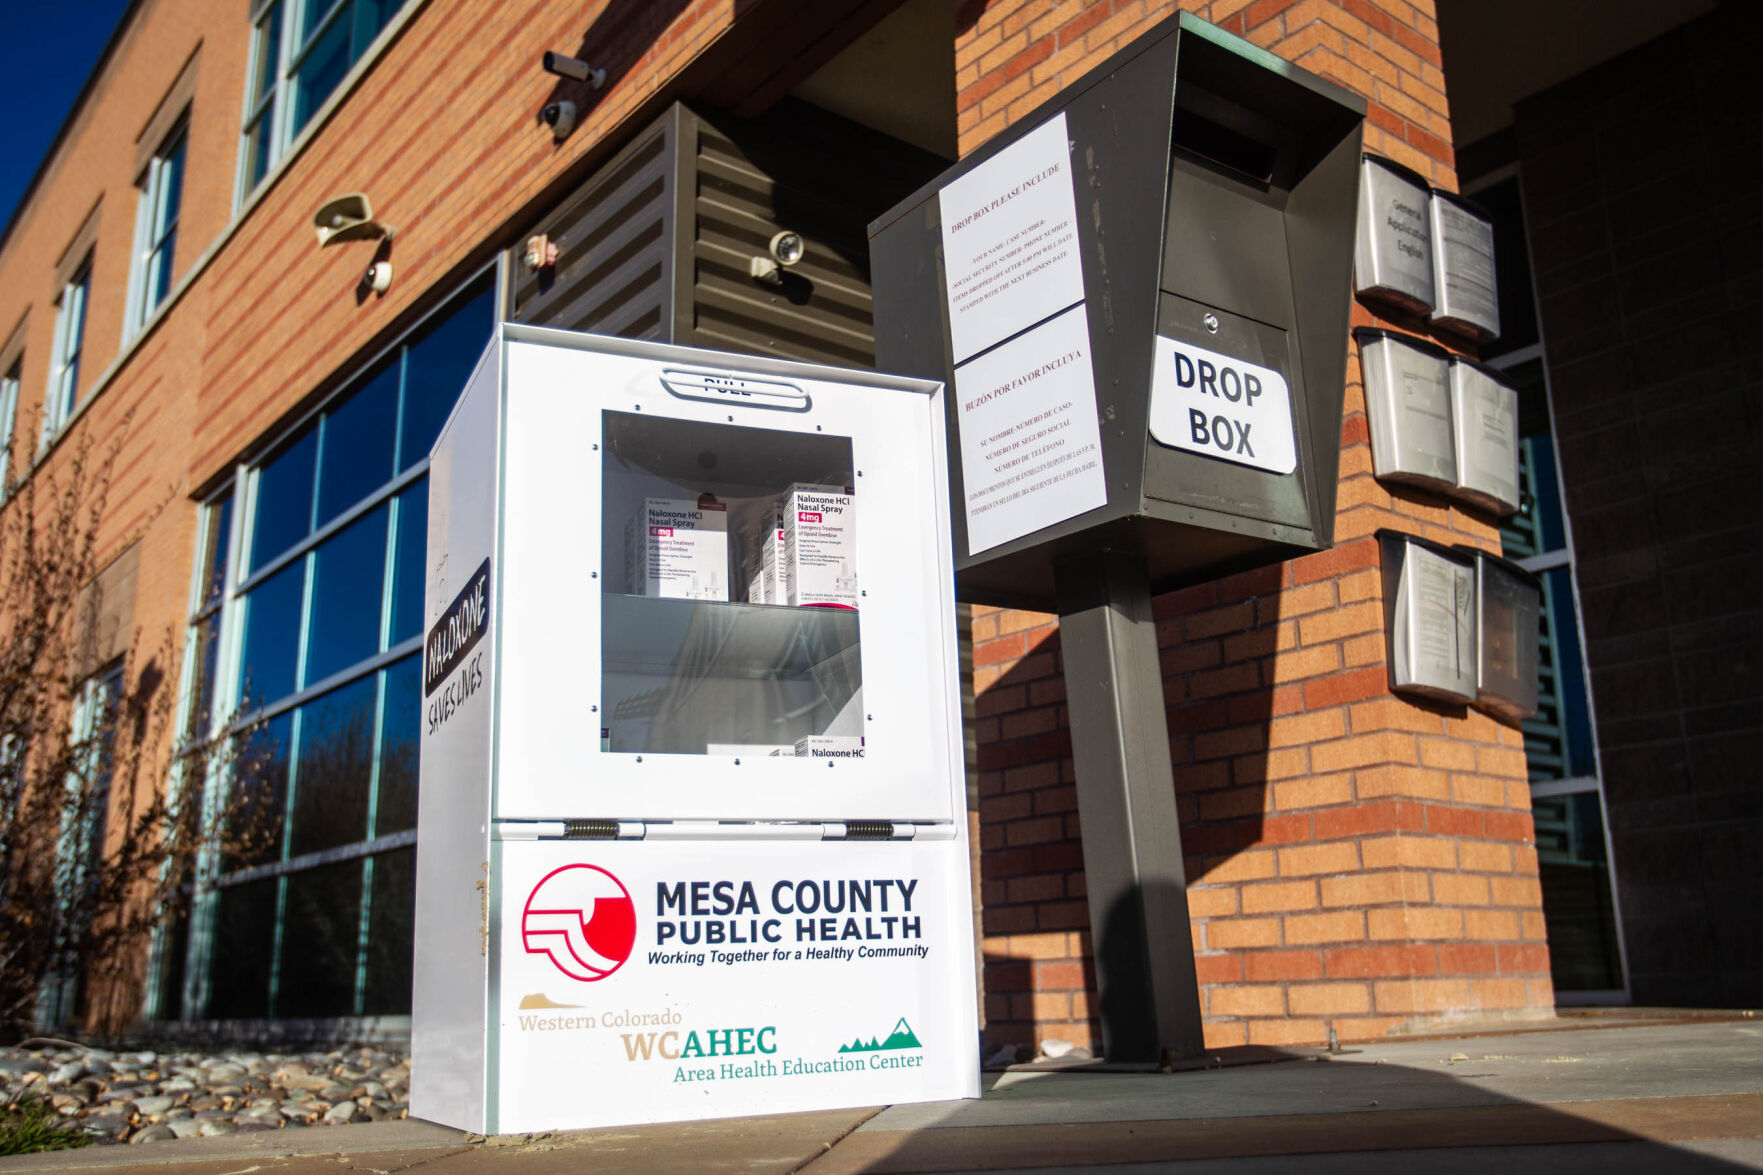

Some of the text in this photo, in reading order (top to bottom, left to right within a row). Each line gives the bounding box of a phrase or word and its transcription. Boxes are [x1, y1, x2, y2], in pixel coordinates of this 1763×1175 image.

[951, 164, 1059, 234] DROP BOX PLEASE INCLUDE
[972, 260, 998, 277] SECURITY
[969, 277, 993, 294] DROPPED
[960, 296, 984, 312] STAMPED
[965, 350, 1081, 411] BUZÓN POR FAVOR INCLUYA
[1174, 351, 1262, 407] DROP
[1189, 407, 1255, 458] BOX
[797, 494, 835, 505] Naloxone
[797, 503, 843, 514] Nasal Spray
[648, 508, 687, 519] Naloxone
[648, 517, 695, 529] Nasal Spray
[428, 573, 486, 684] NALOXONE
[428, 652, 483, 737] SAVES LIVES
[811, 748, 851, 758] Naloxone
[852, 749, 864, 758] HC
[656, 878, 919, 917] MESA COUNTY
[656, 915, 922, 946] PUBLIC HEALTH
[648, 943, 930, 967] Working Together for a Healthy Community
[518, 1009, 683, 1032] Western Colorado
[620, 1025, 778, 1062] WCAHEC
[673, 1052, 924, 1083] Area Health Education Center
